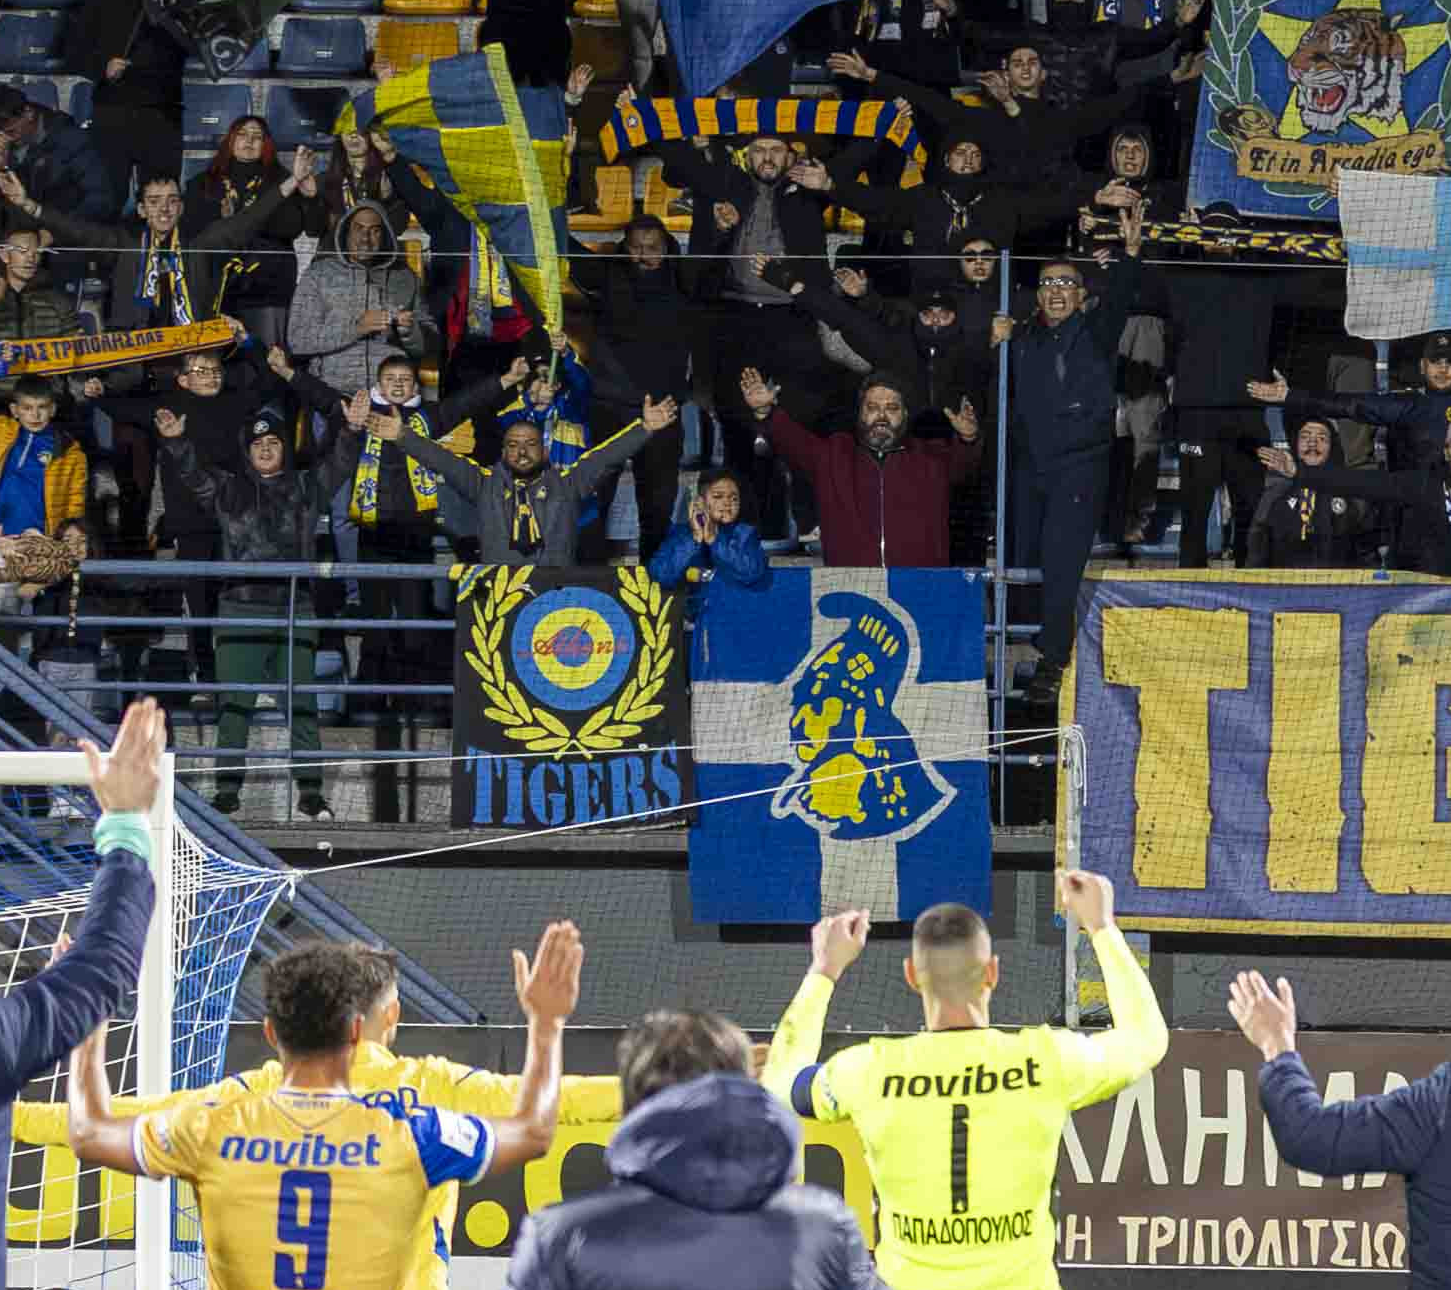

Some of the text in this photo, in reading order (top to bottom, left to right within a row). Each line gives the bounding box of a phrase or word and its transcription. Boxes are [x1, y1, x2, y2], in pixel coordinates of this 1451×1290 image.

[465, 744, 683, 827] TIGERS
[881, 1057, 1042, 1099] novibet
[220, 1133, 382, 1167] novibet
[951, 1103, 970, 1215] 1
[892, 1209, 1034, 1246] ΠΑΠΑΔΟΠΟΥΛΟΣ
[1117, 1215, 1409, 1270] ΤΡΙΠΟΛΙΤΣΙΩ
